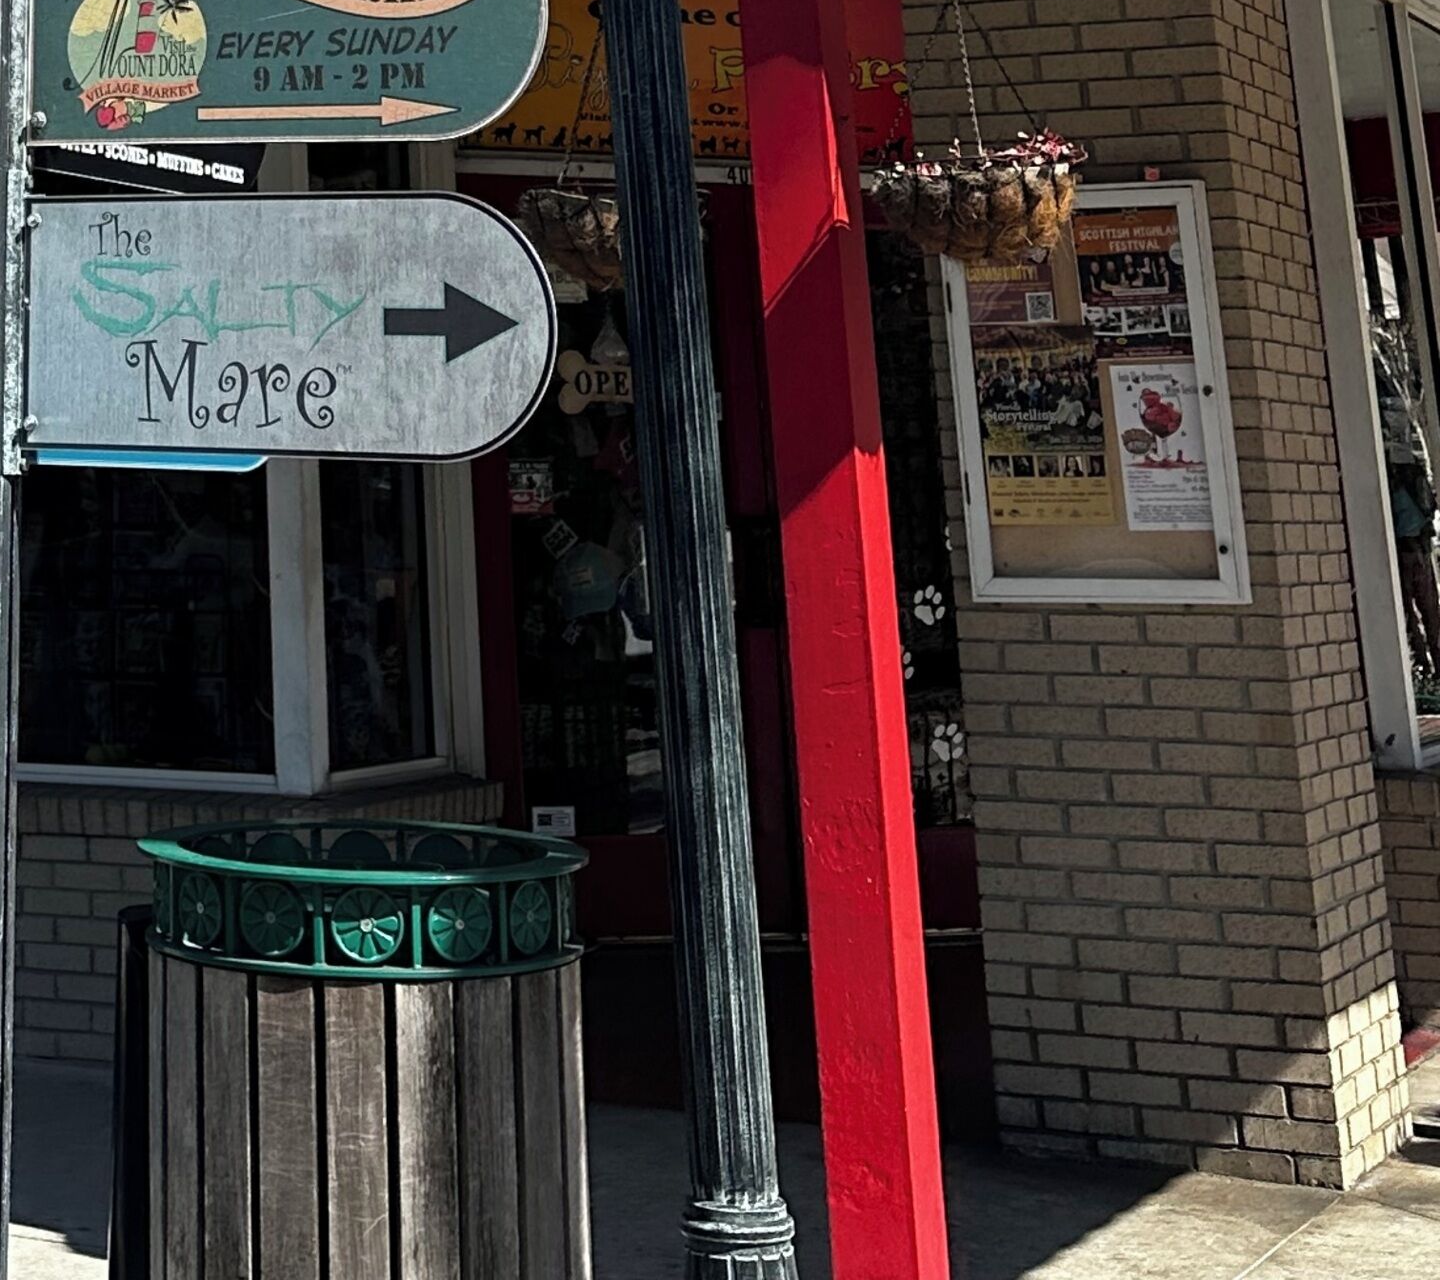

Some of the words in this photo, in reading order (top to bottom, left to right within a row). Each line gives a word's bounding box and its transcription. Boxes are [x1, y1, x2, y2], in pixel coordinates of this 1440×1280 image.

[160, 35, 187, 55] Visit
[215, 31, 311, 62] EVERY
[325, 25, 458, 58] SUNDAY
[159, 54, 197, 78] DORA
[252, 67, 271, 94] 9
[278, 65, 324, 92] AM
[351, 65, 368, 91] 2
[380, 61, 427, 90] PM
[85, 82, 140, 104] VILLAGE
[142, 83, 195, 99] MARKET
[88, 211, 153, 258] The
[1079, 227, 1130, 242] SCOTTISH
[1108, 238, 1161, 252] FESTIVAL
[70, 260, 368, 352] SALTY
[125, 338, 337, 430] Mare
